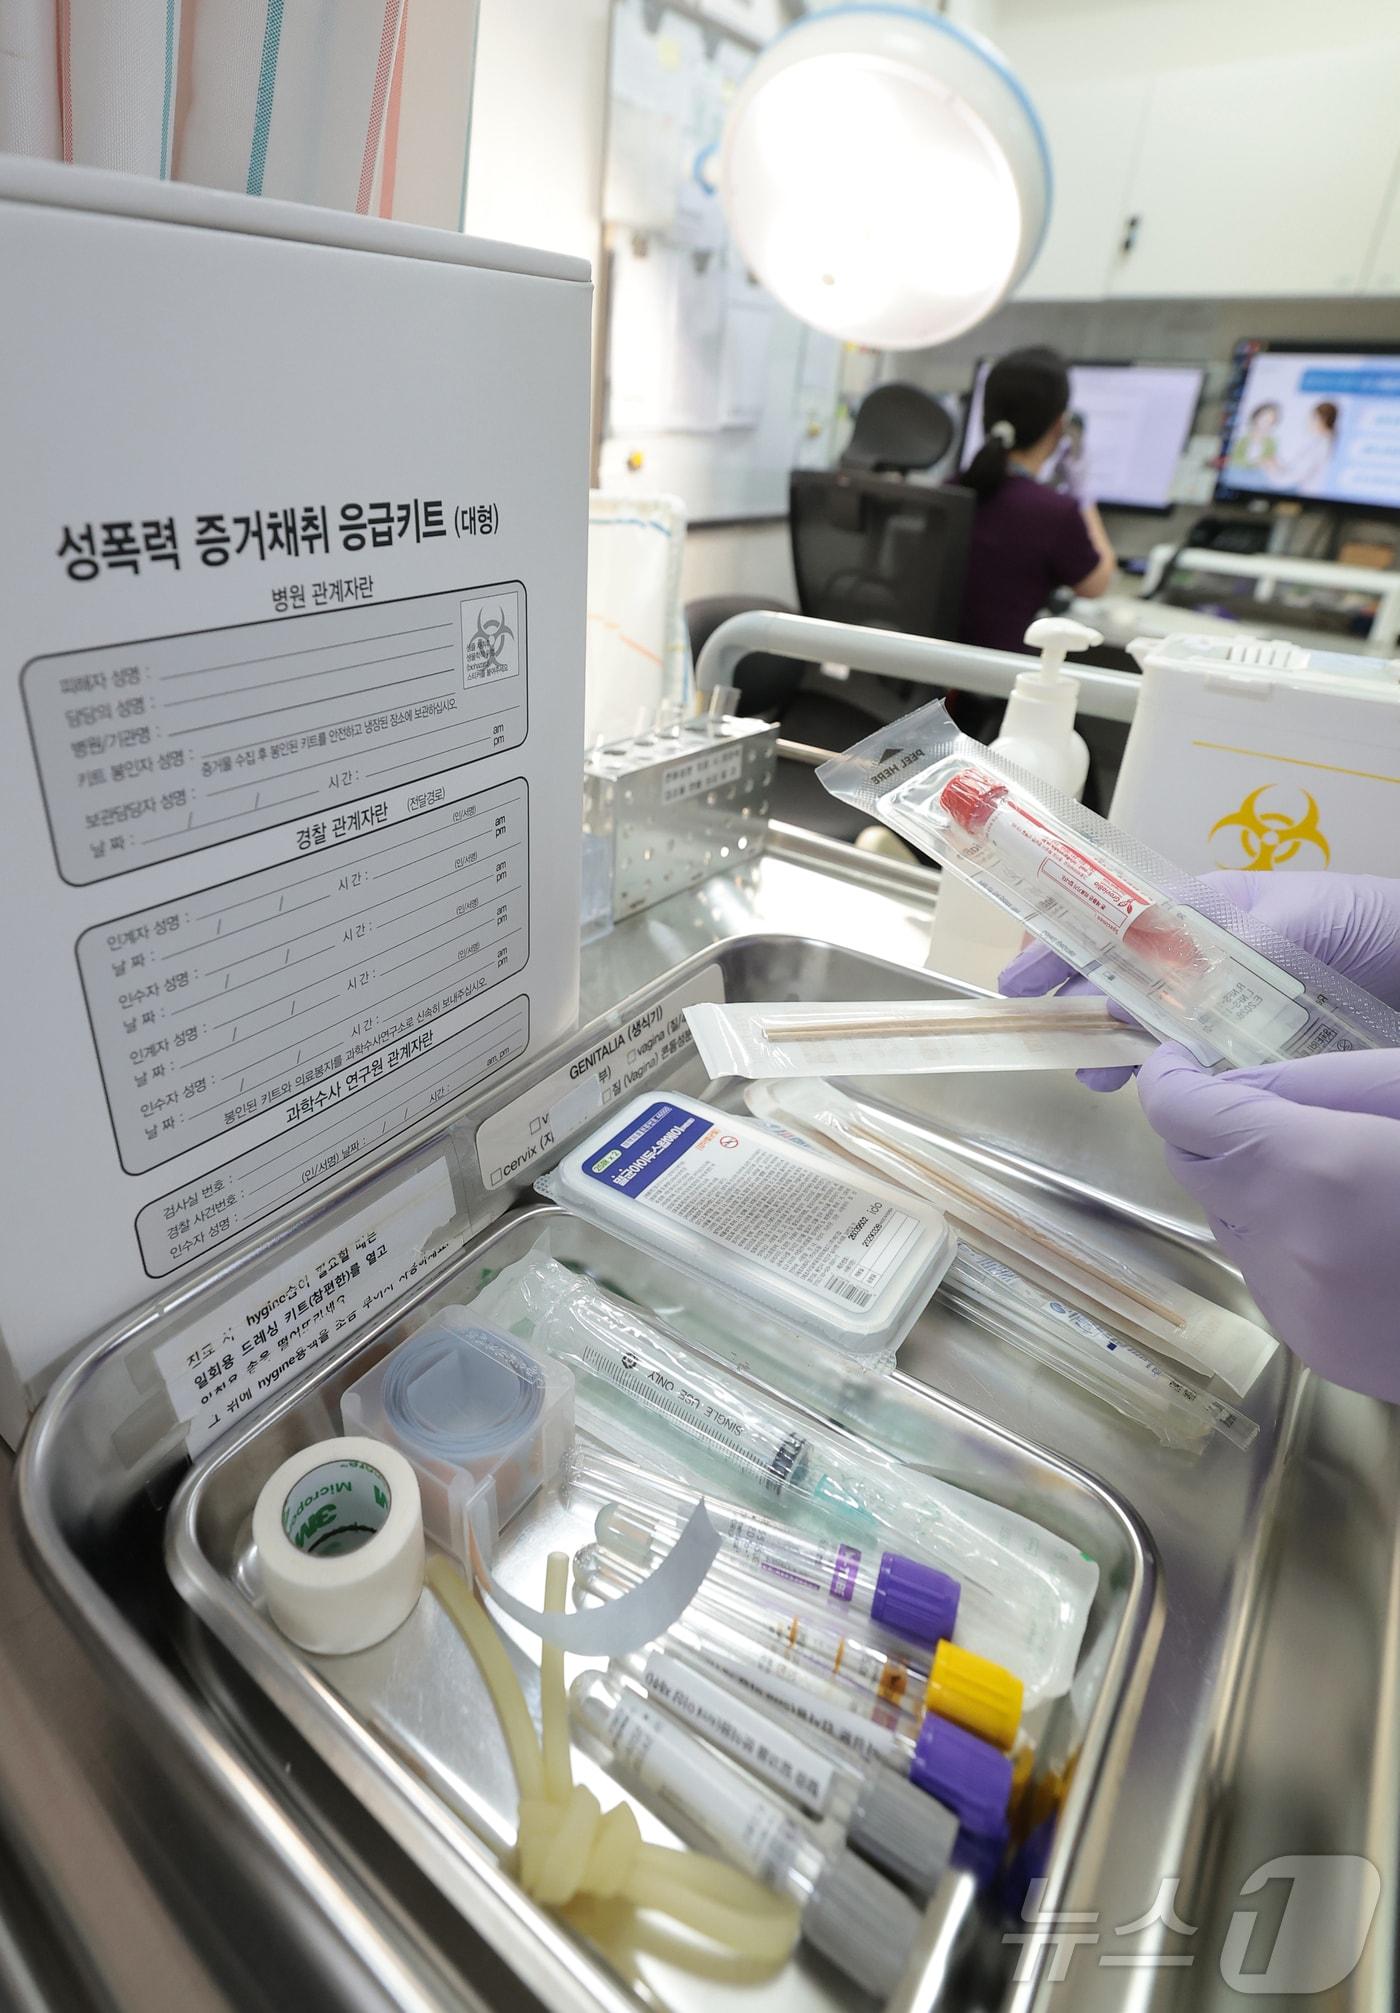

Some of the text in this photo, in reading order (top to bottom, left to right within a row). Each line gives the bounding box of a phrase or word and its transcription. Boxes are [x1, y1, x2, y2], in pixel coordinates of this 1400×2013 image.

[57, 498, 500, 583] 성폭력 증거채취 응급키트 (대형)
[271, 574, 375, 613] 병원 관계자란
[111, 665, 141, 688] 성명
[116, 696, 145, 719] 성명
[201, 755, 232, 778] 증거물
[235, 749, 256, 767] 수집
[258, 746, 269, 762] 후
[270, 738, 300, 760] 봉인된
[301, 731, 327, 751] 키트를
[329, 722, 363, 744] 안전하고
[364, 715, 388, 735] 냉장된
[390, 709, 413, 727] 장소에
[493, 722, 505, 735] am
[493, 734, 505, 747] pm
[157, 749, 185, 771] 성명
[160, 788, 187, 811] 성명
[296, 786, 446, 851] 경찰 관계자란 (전달경로)
[495, 814, 506, 827] am
[495, 825, 507, 838] pm
[495, 859, 507, 872] am
[496, 870, 507, 883] pm
[496, 903, 507, 916] am
[497, 914, 508, 927] pm
[106, 925, 149, 952] 인계자
[153, 914, 180, 936] 성명
[497, 946, 508, 959] am
[497, 956, 508, 969] pm
[118, 983, 160, 1010] 인수자
[163, 970, 189, 993] 성명
[129, 1038, 170, 1066] 인계자
[173, 1025, 199, 1048] 성명
[568, 1004, 665, 1081] GENITALIA (생식기)
[635, 1029, 667, 1057] vagina
[223, 1101, 258, 1126] 봉인된
[261, 1081, 292, 1104] 키트와
[295, 1054, 343, 1087] 의료봉지를
[345, 1017, 414, 1060] 과학수사연구소로
[416, 1003, 441, 1025] 신속히
[286, 1028, 434, 1125] 과학수사 연구원 관계자란
[140, 1091, 180, 1119] 인수자
[183, 1077, 208, 1099] 성명
[169, 1230, 205, 1260] 인수자
[208, 1217, 232, 1238] 성명
[301, 1153, 340, 1184] (인/서명)
[341, 1139, 361, 1161] 날짜
[429, 1088, 445, 1103] 시간
[502, 1145, 539, 1177] cervix
[163, 1179, 226, 1221] 검사실 번호
[167, 1196, 238, 1240] 경찰 사건번호
[193, 1353, 235, 1390] 일회용
[240, 1321, 279, 1357] 드레싱
[283, 1261, 361, 1332] 키트(참편한)를
[365, 1245, 389, 1267] 열고
[647, 1369, 745, 1437] SINGLE USE ONLY
[295, 1503, 337, 1548] 3M
